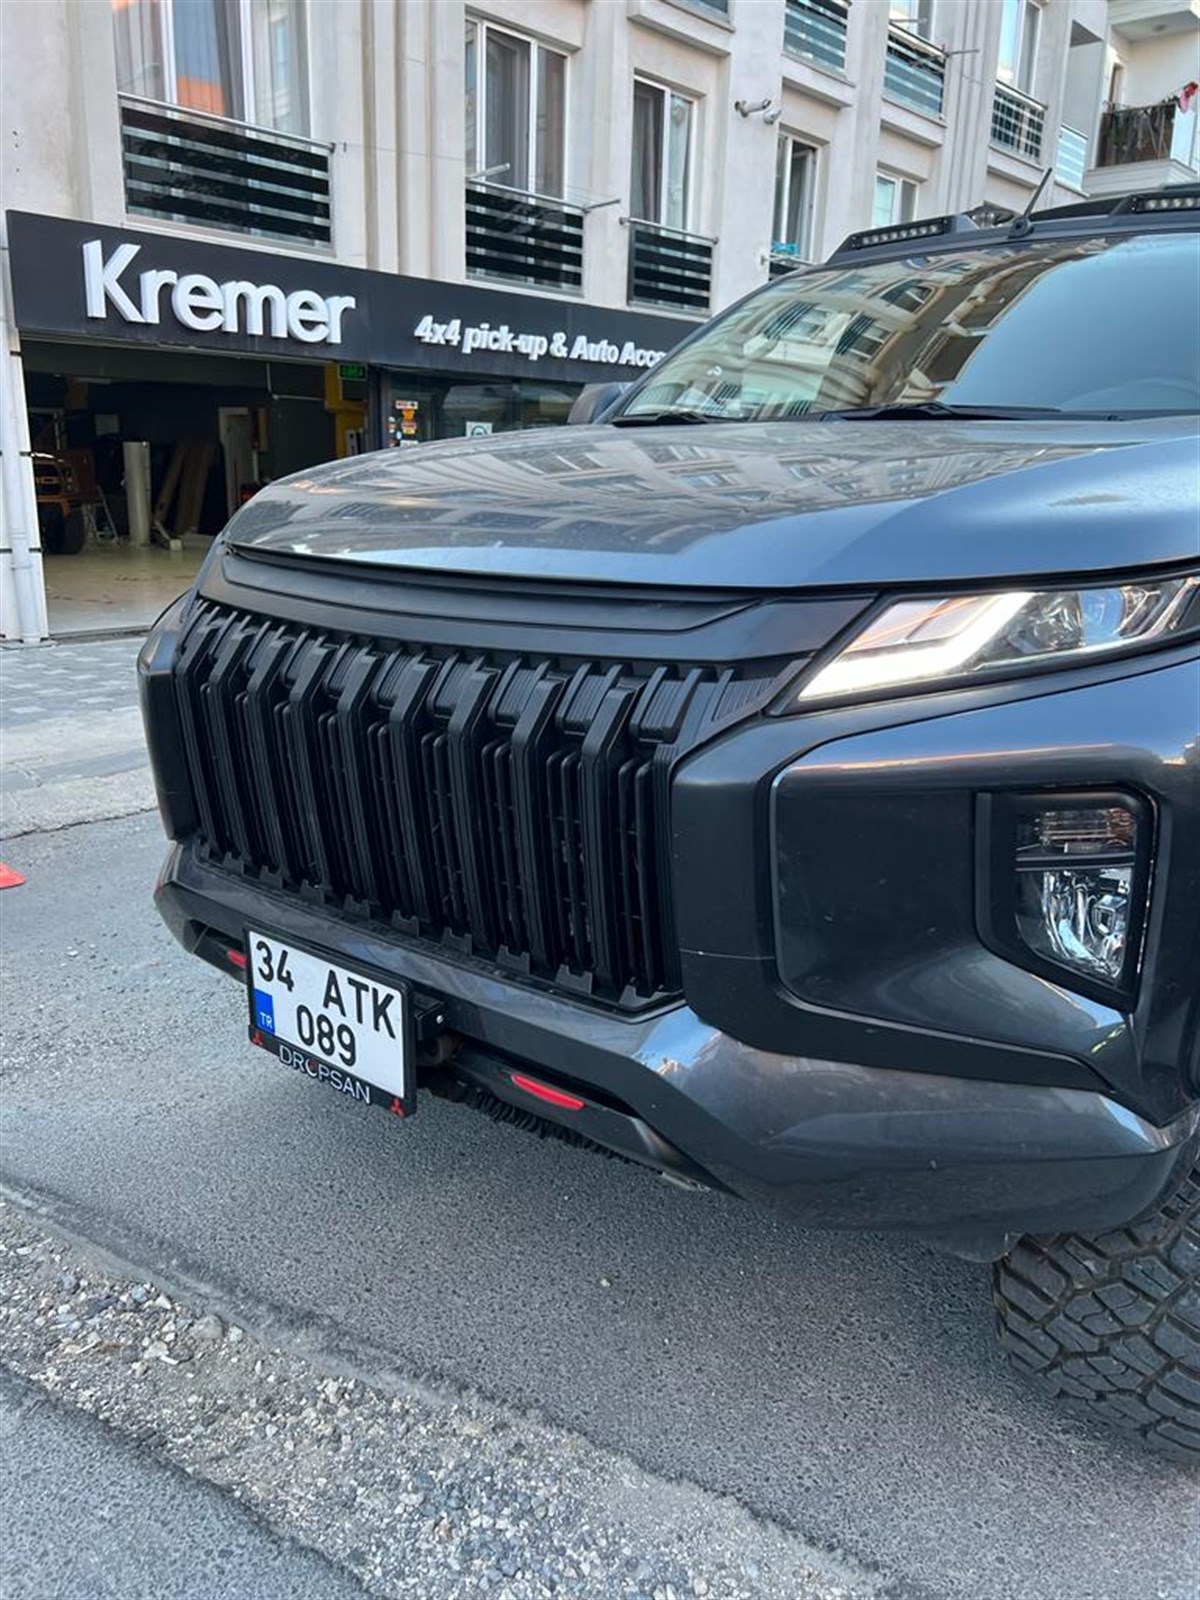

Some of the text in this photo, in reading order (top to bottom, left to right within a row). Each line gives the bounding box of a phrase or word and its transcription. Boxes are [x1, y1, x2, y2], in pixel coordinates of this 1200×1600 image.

[82, 239, 356, 344] Kremer
[414, 315, 461, 346] 4x4
[462, 323, 548, 361] pick-up
[550, 332, 568, 358] &
[569, 335, 619, 364] Auto
[256, 940, 396, 1040] 34 ATK
[260, 1012, 273, 1030] TR
[296, 1004, 356, 1067] 089
